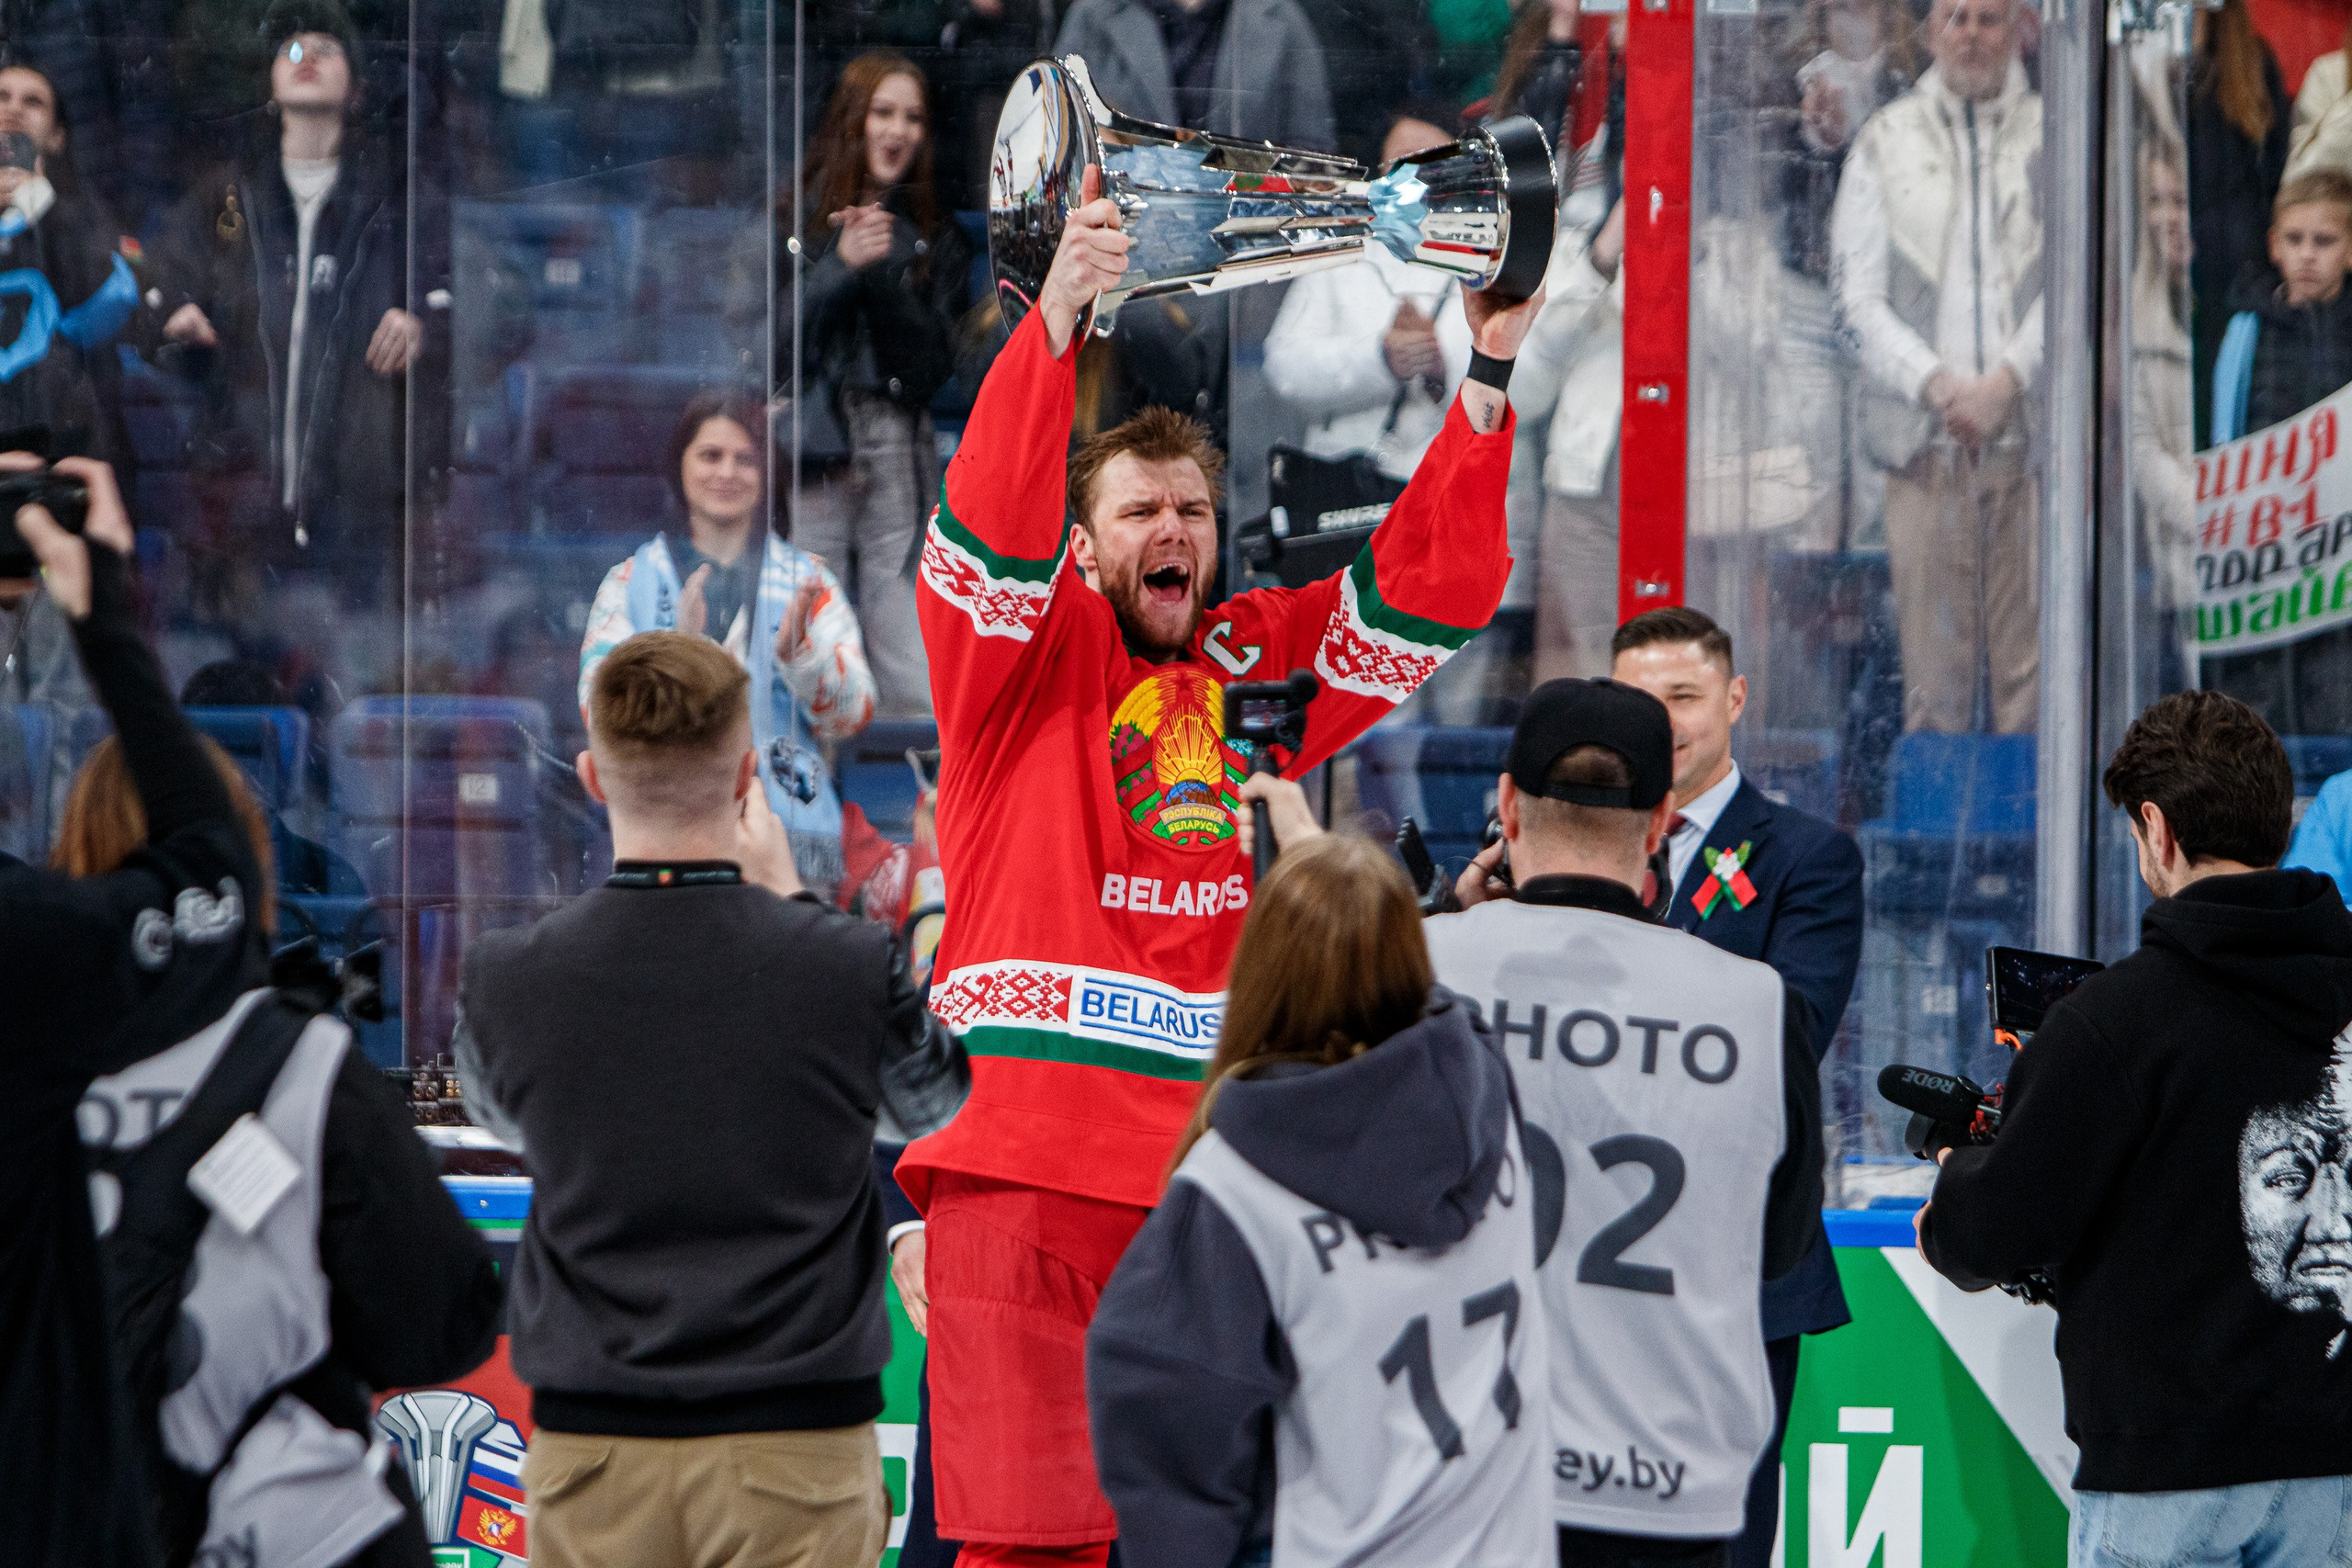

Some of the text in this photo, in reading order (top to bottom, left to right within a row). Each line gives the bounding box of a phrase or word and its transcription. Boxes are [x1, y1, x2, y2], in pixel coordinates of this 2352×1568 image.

[1202, 621, 1262, 676] C
[1163, 806, 1223, 822] РЭСПУБЛІКА
[1168, 819, 1220, 834] БЕЛАРУСЬ
[1080, 987, 1222, 1039] BELARUS
[1378, 1277, 1521, 1461] 17
